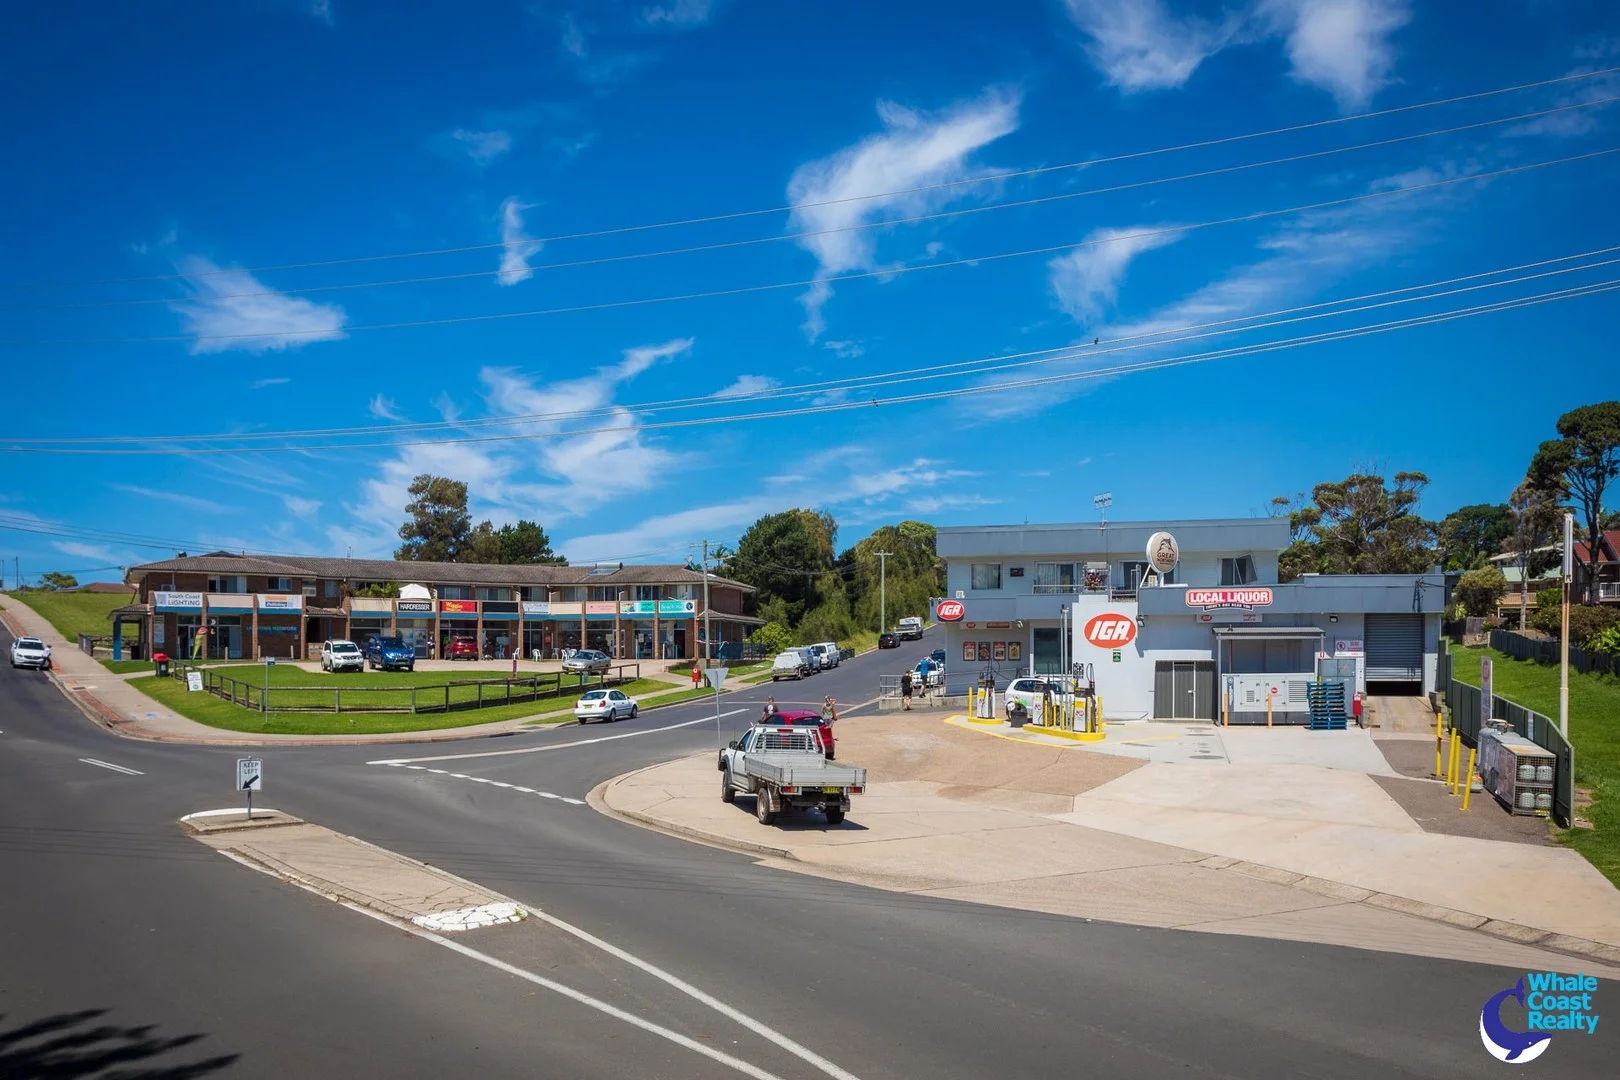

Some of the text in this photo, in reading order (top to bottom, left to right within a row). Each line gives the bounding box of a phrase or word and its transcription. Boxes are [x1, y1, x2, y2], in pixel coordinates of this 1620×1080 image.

[1190, 592, 1225, 602] LOCAL
[940, 604, 960, 616] IGA
[1089, 620, 1131, 641] IGA
